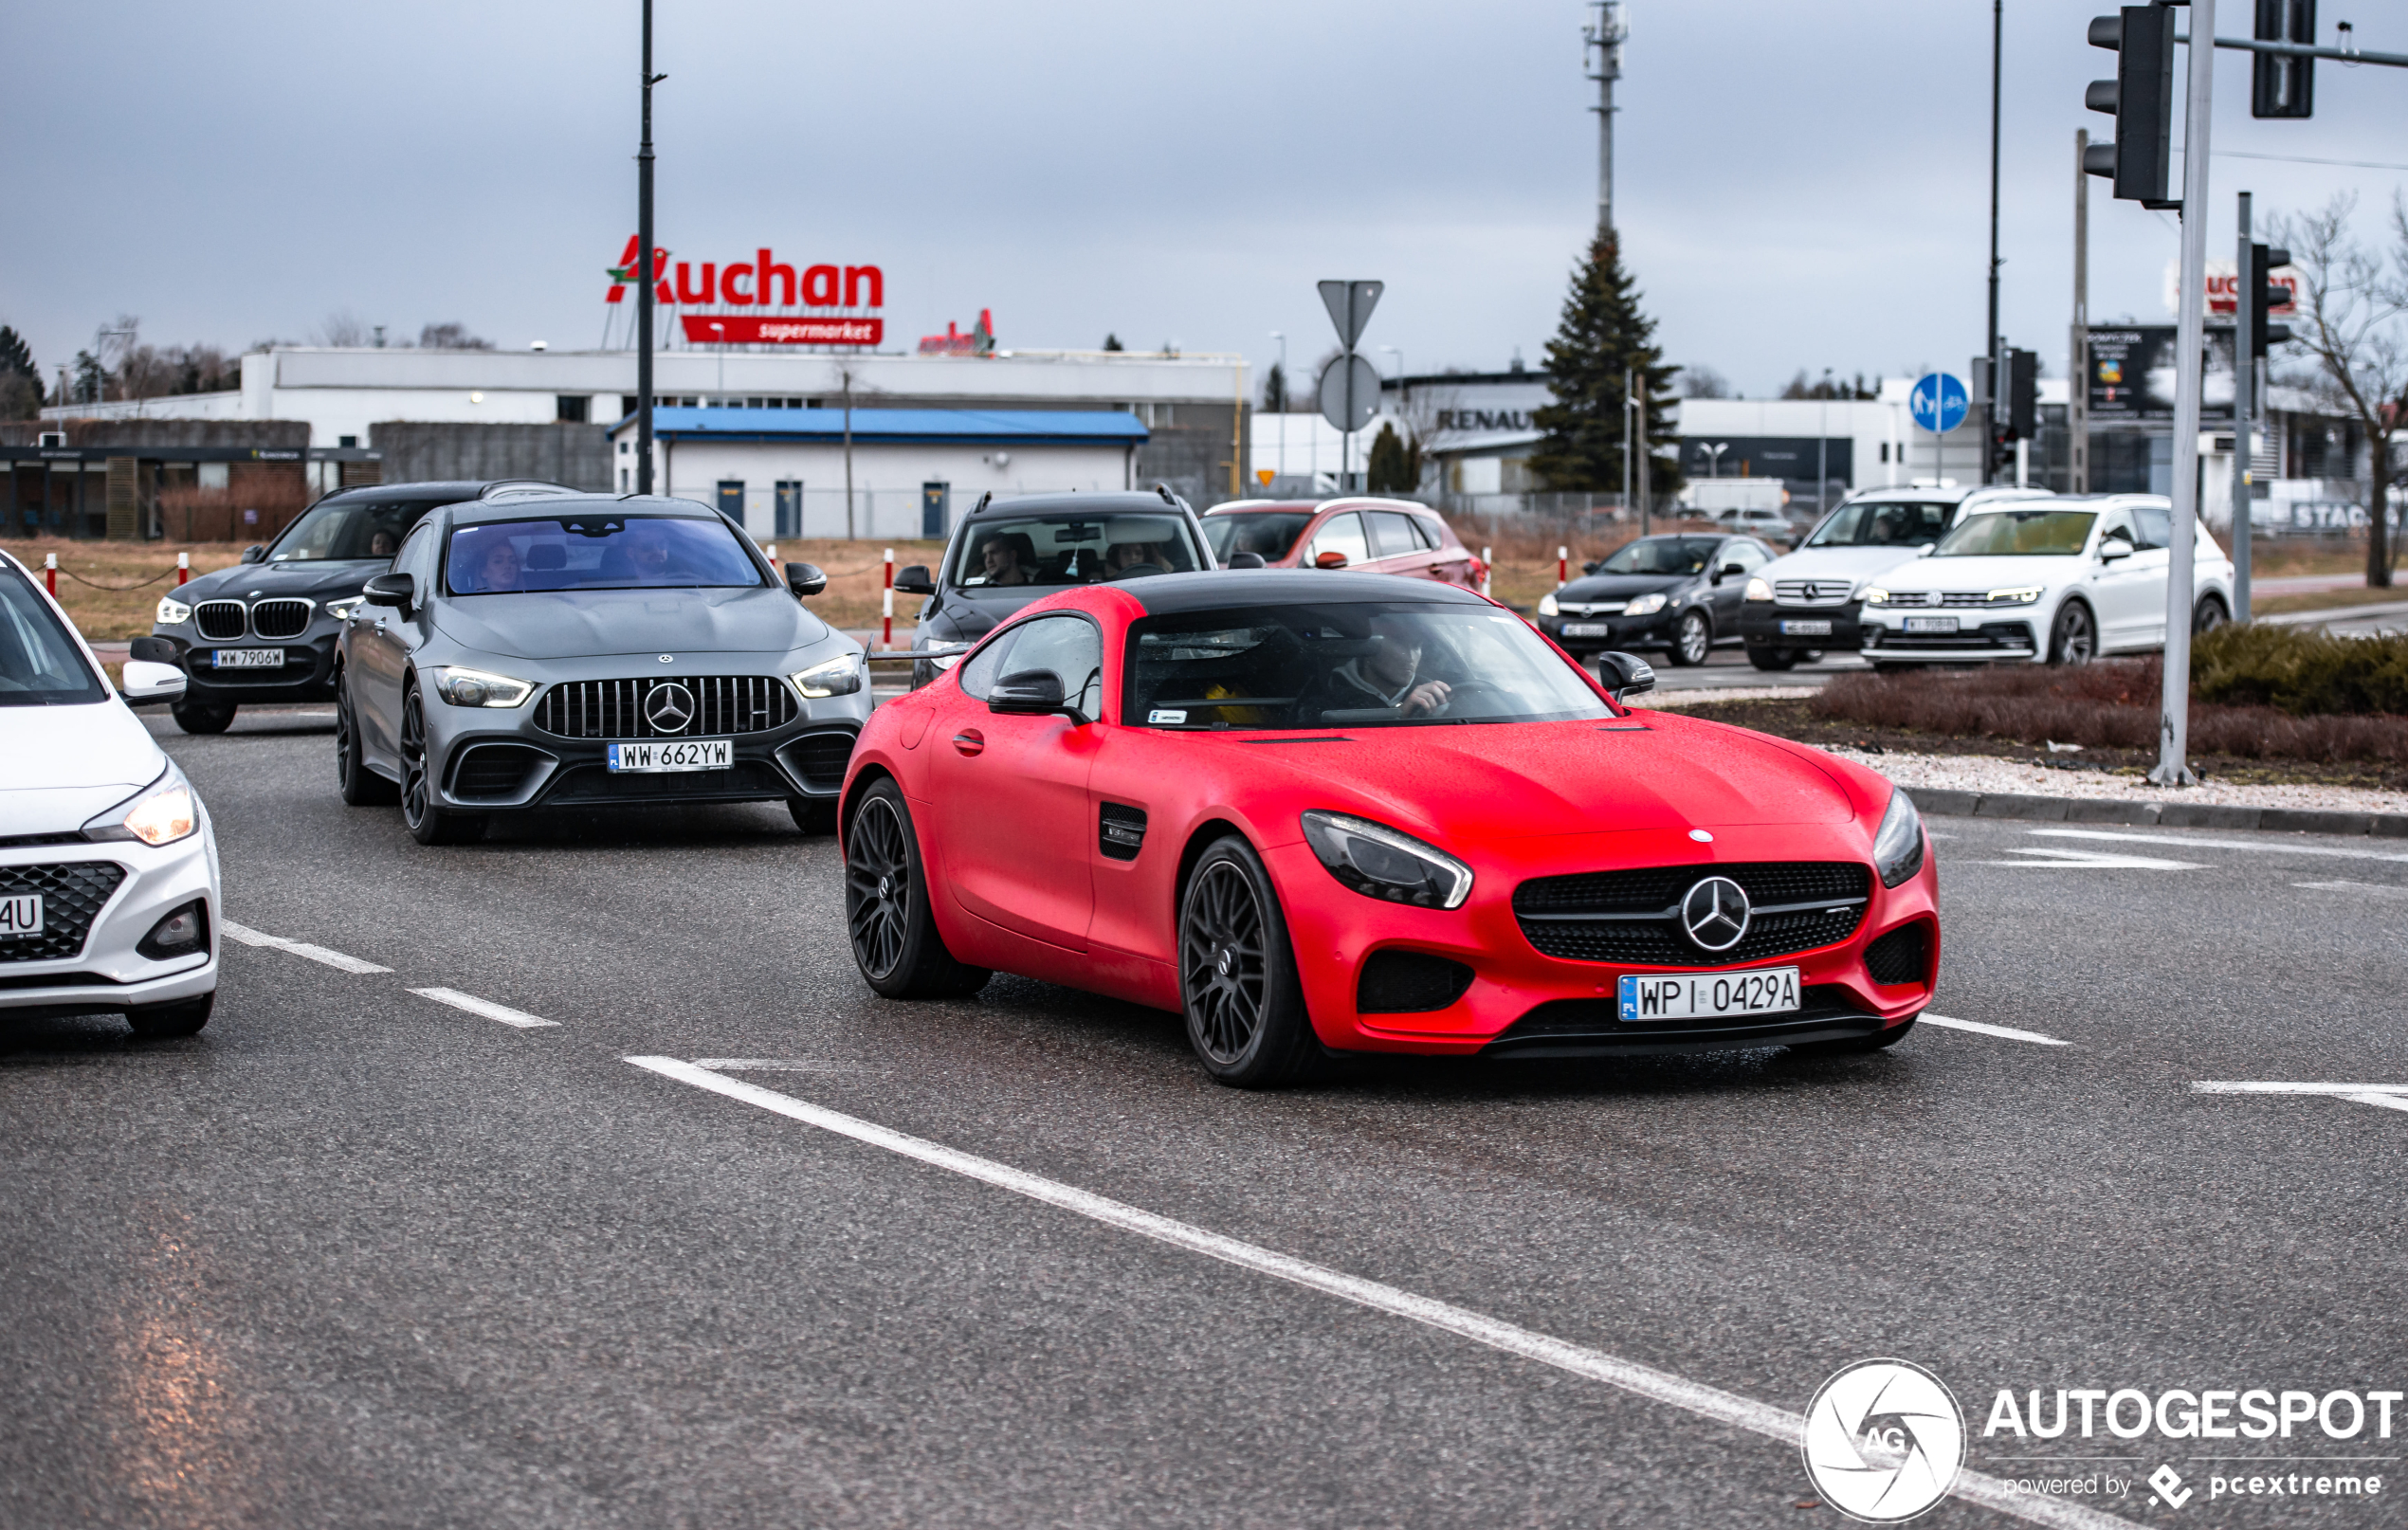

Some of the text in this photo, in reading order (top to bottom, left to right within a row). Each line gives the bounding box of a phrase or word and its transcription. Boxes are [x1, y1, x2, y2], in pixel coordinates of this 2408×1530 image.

[605, 234, 884, 307] Auchan
[758, 322, 873, 342] supermarket
[1437, 409, 1534, 430] RENAU
[221, 650, 281, 665] WW 7906W
[624, 742, 726, 767] WW 662YW
[1641, 973, 1797, 1015] WPI 0429A
[1623, 1002, 1636, 1012] PL
